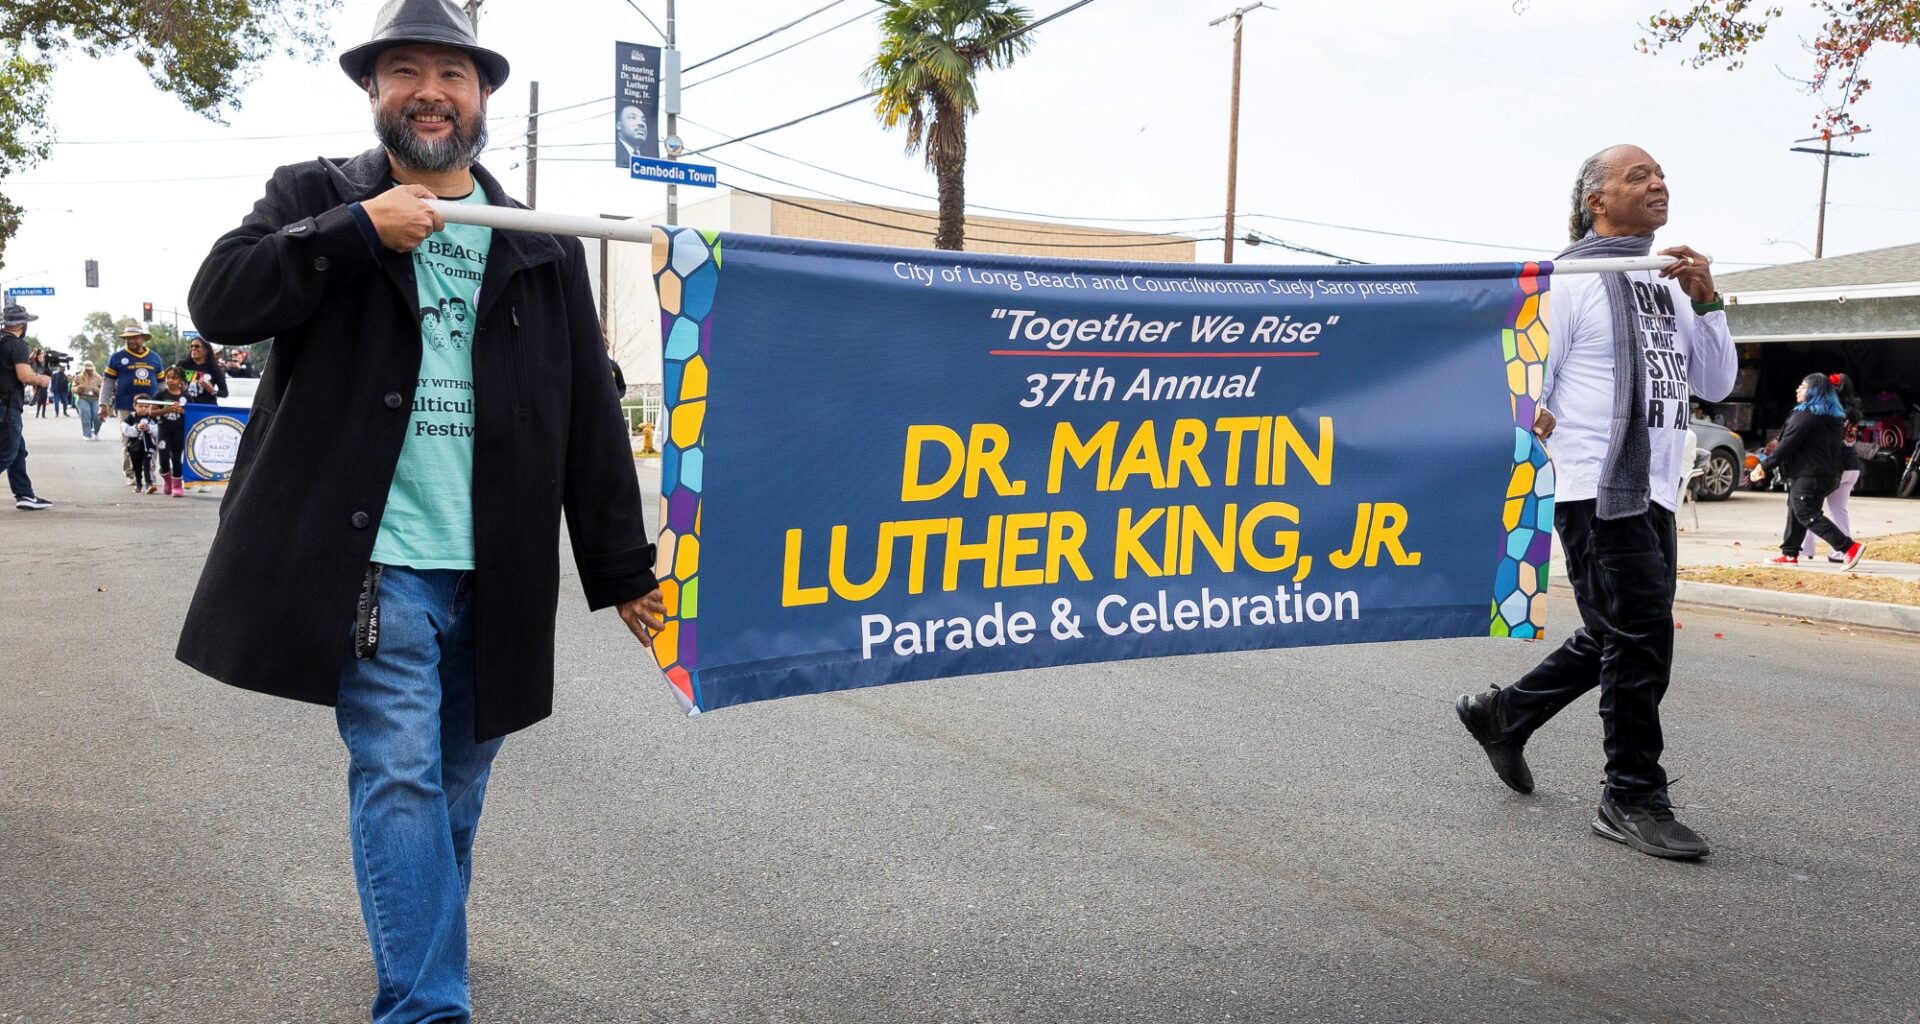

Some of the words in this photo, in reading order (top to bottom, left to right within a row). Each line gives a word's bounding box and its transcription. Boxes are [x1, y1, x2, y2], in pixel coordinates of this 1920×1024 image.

[620, 71, 631, 80] Dr.
[632, 73, 655, 83] Martin
[621, 63, 654, 76] Honoring
[624, 88, 641, 98] King,
[626, 80, 649, 90] Luther
[632, 162, 685, 180] Cambodia
[688, 168, 715, 183] Town
[436, 262, 484, 281] Comm
[893, 262, 934, 286] City
[941, 265, 962, 283] of
[967, 267, 1023, 291] Long
[1023, 270, 1087, 289] Beach
[1092, 274, 1128, 291] and
[1132, 276, 1267, 295] Councilwoman
[1268, 278, 1314, 299] Suely
[1316, 279, 1355, 296] Saro
[1357, 280, 1419, 300] present
[990, 308, 1182, 350] "Together
[1190, 315, 1245, 344] We
[1250, 315, 1340, 344] Rise"
[1650, 332, 1675, 351] MAKE
[1645, 349, 1687, 382] STIC
[431, 378, 474, 390] WITHIN
[1019, 367, 1117, 409] 37th
[1121, 366, 1262, 401] Annual
[411, 396, 475, 415] ulticul
[1647, 399, 1665, 428] R
[415, 420, 475, 438] Festiv
[900, 423, 1026, 502] DR.
[1046, 415, 1334, 494] MARTIN
[781, 510, 1094, 607] LUTHER
[1113, 501, 1313, 583] KING,
[1328, 502, 1422, 570] JR.
[861, 601, 1037, 660] Parade
[1050, 597, 1085, 641] &
[1096, 582, 1360, 636] Celebration
